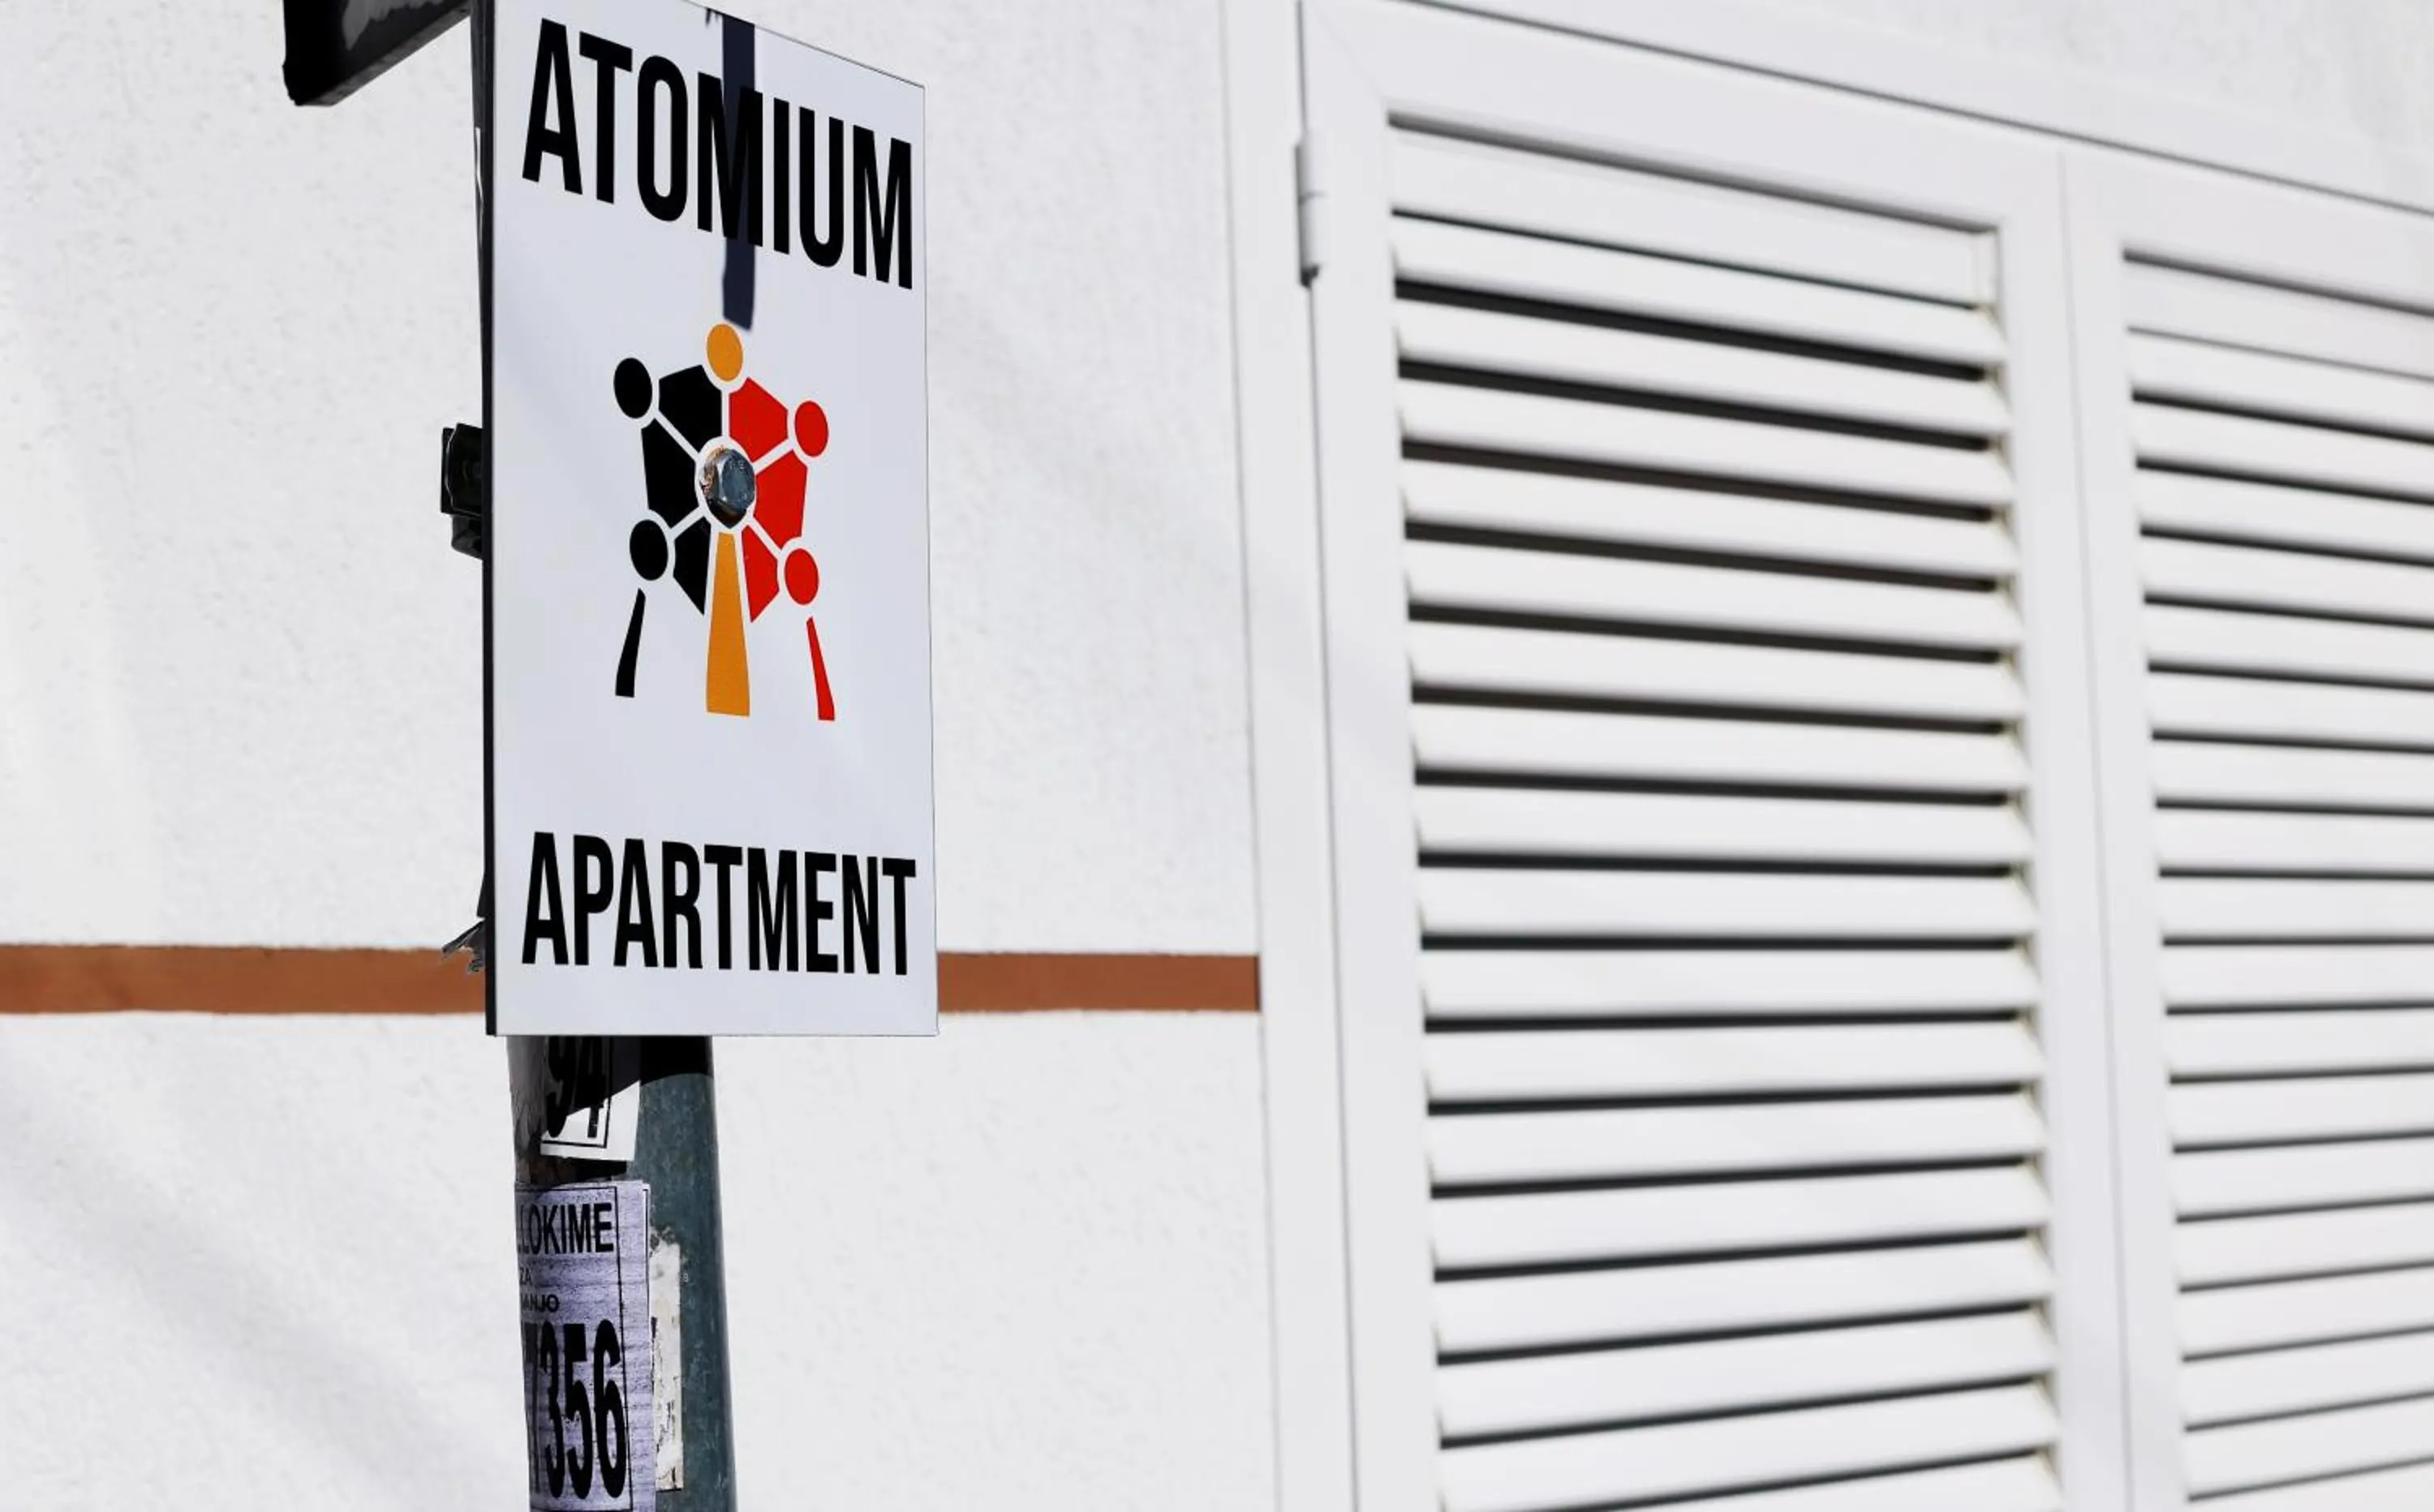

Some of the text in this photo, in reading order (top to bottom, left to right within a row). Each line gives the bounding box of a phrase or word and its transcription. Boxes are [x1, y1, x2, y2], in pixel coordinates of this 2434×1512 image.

[522, 18, 913, 290] ATOMIUM
[522, 831, 917, 976] APARTMENT
[518, 1202, 613, 1255] LOKIME
